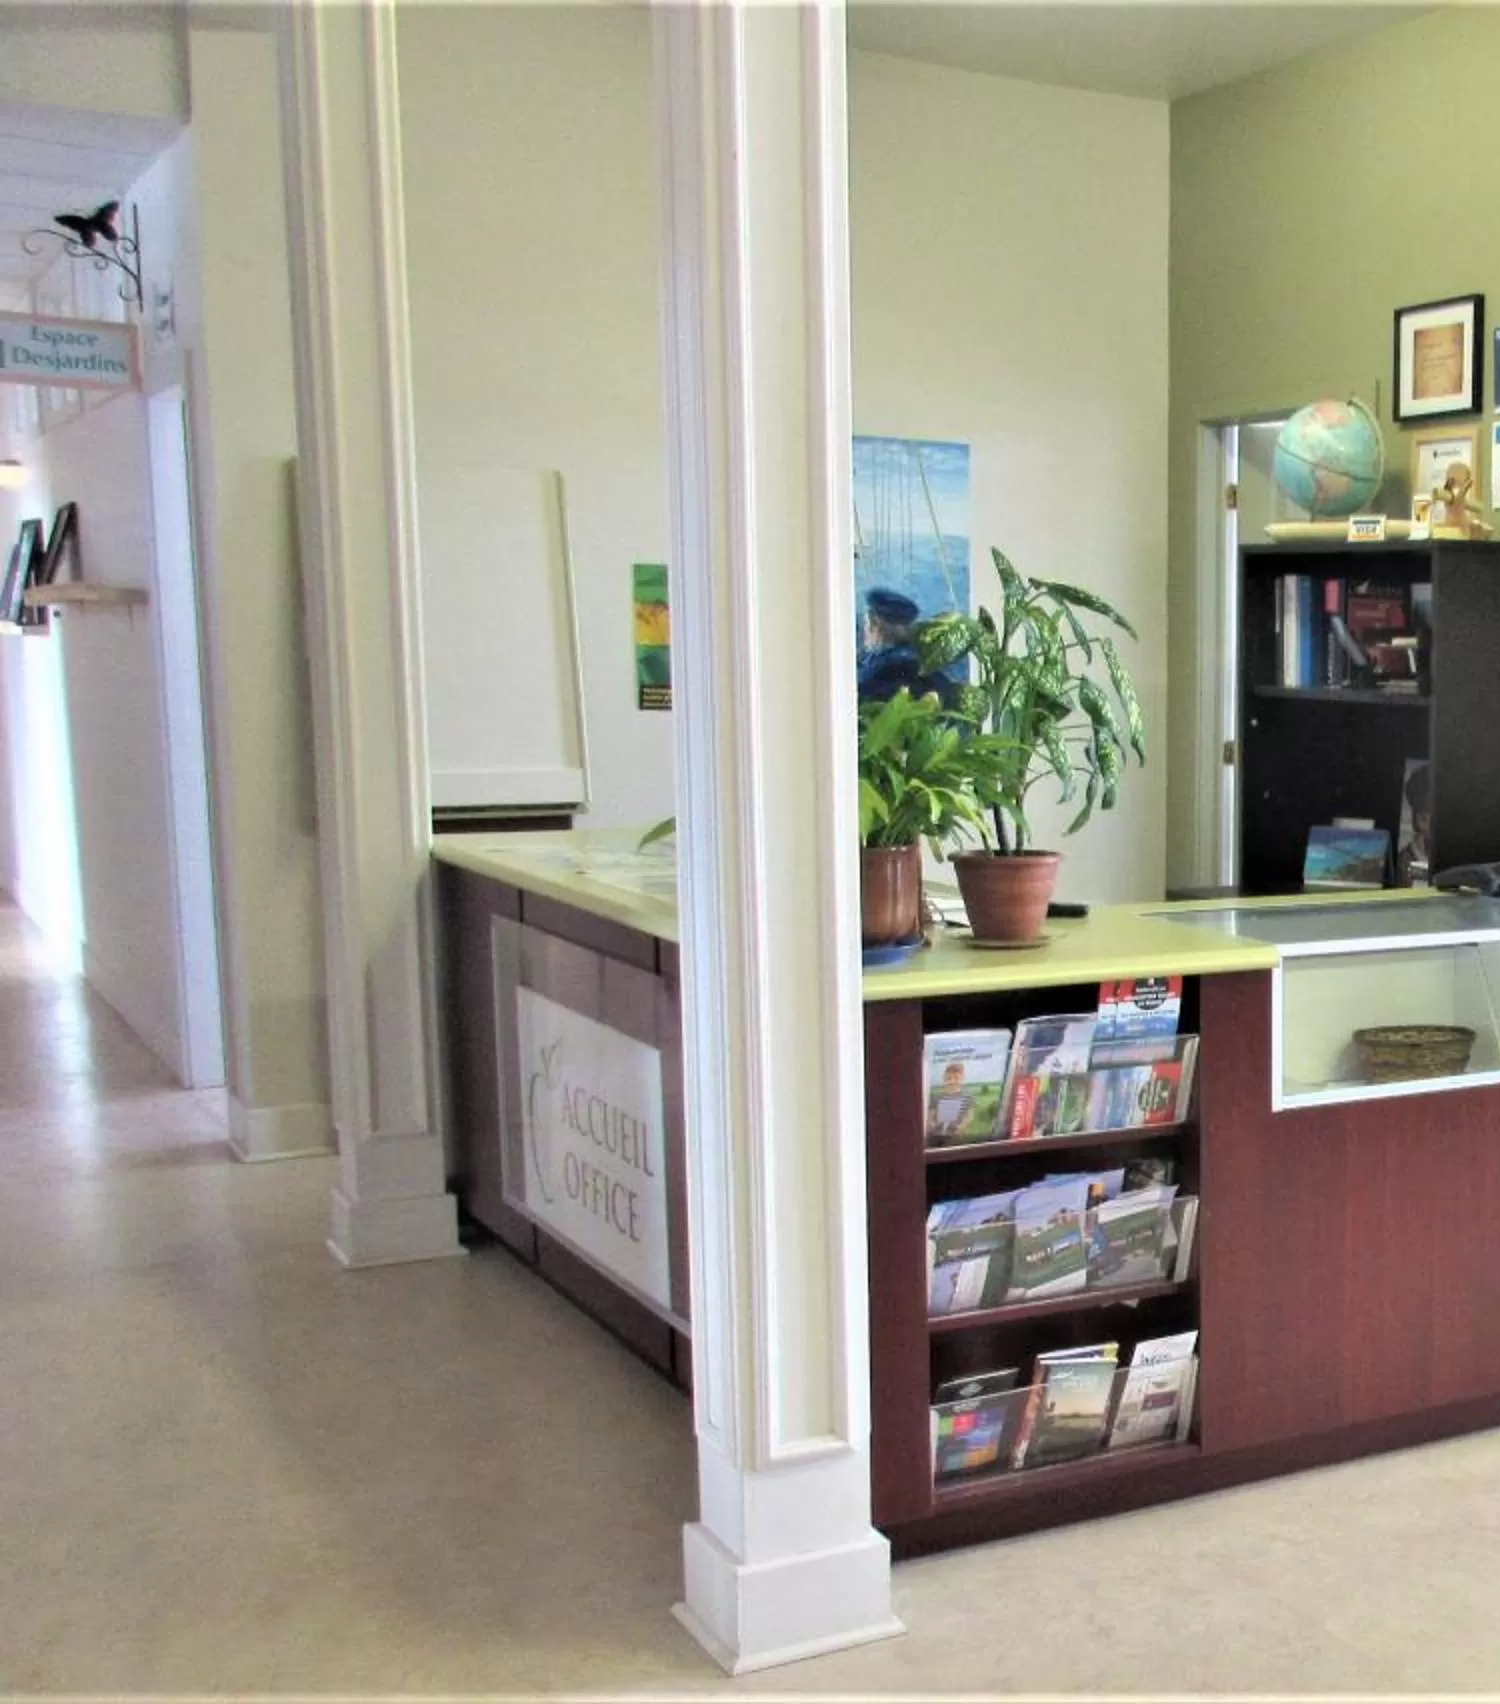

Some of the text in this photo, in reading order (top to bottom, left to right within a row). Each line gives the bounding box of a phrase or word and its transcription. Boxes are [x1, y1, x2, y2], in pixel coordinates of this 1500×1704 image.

[12, 346, 128, 373] Desjardins
[31, 325, 99, 347] Espace
[562, 1079, 654, 1177] ACCUEIL
[563, 1150, 641, 1242] OFFICE
